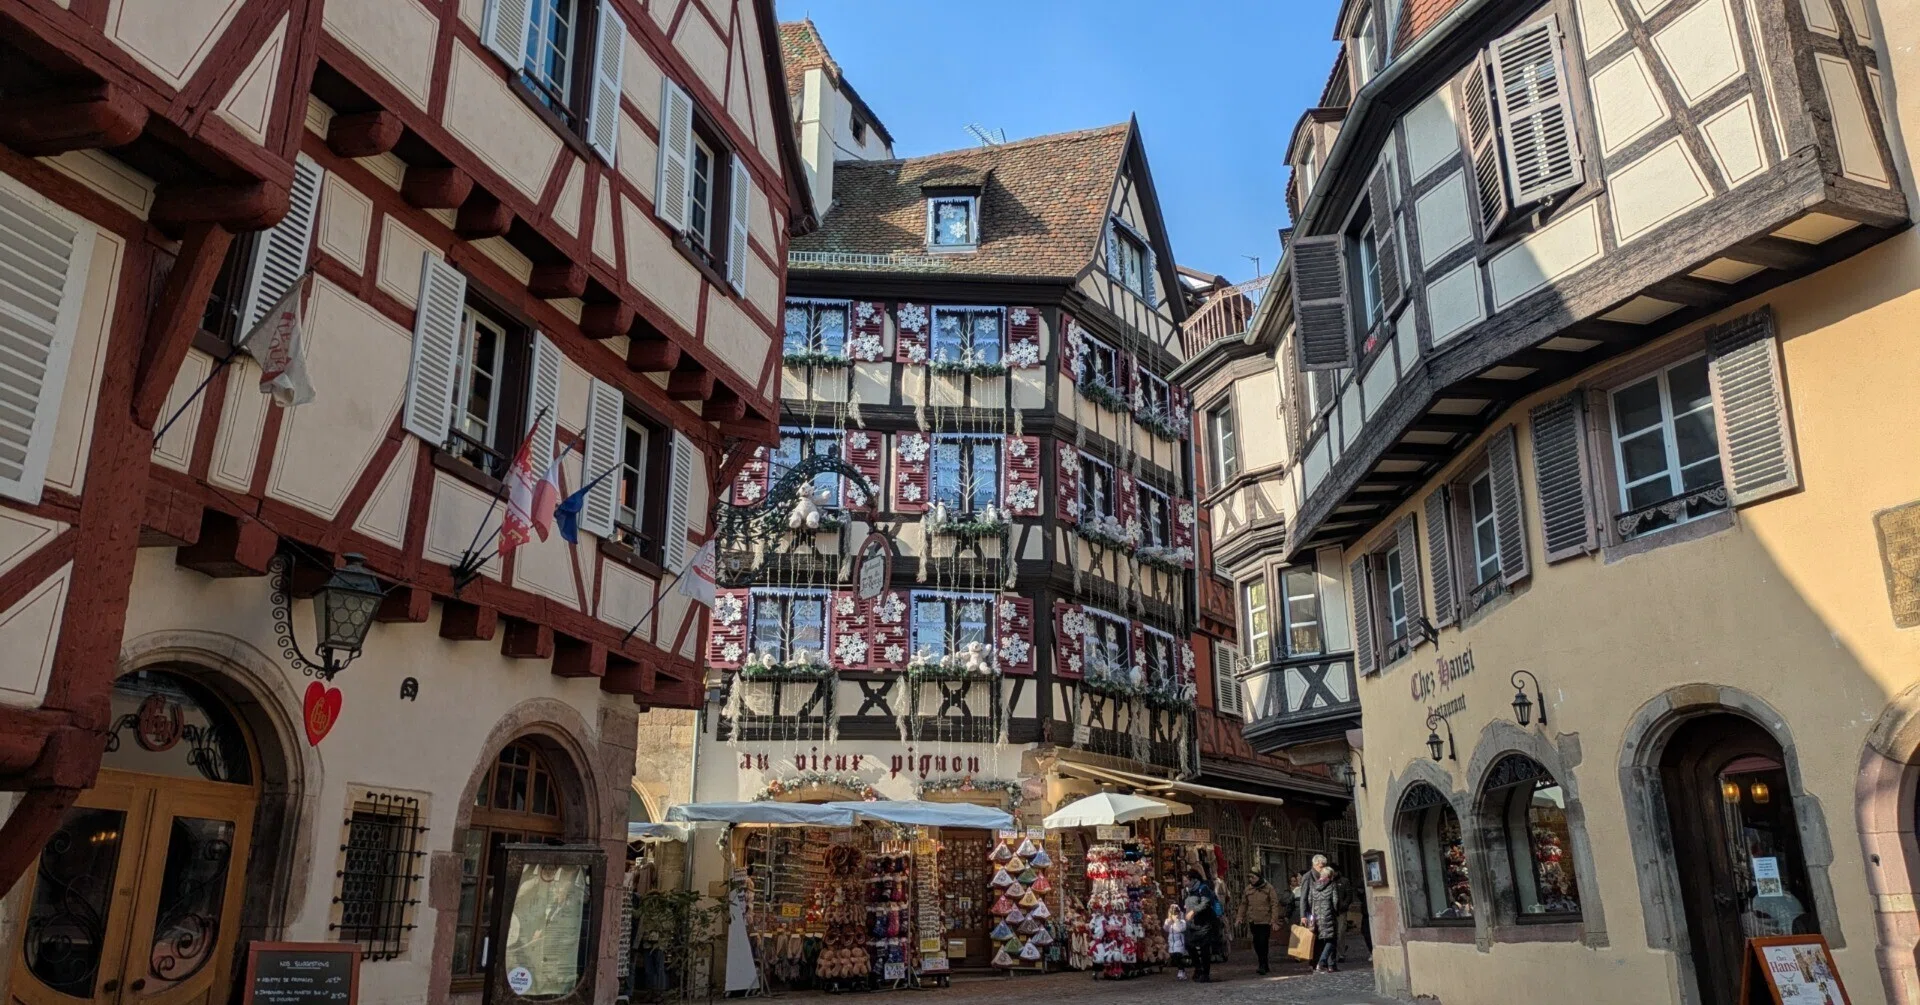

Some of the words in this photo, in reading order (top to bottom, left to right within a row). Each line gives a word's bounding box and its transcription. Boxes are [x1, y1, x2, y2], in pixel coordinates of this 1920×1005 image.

[1411, 669, 1435, 703] Chez
[1436, 642, 1475, 692] Hansi
[739, 752, 769, 770] au
[794, 746, 864, 772] vieux
[890, 746, 980, 780] pignon
[1769, 959, 1799, 973] Hansi
